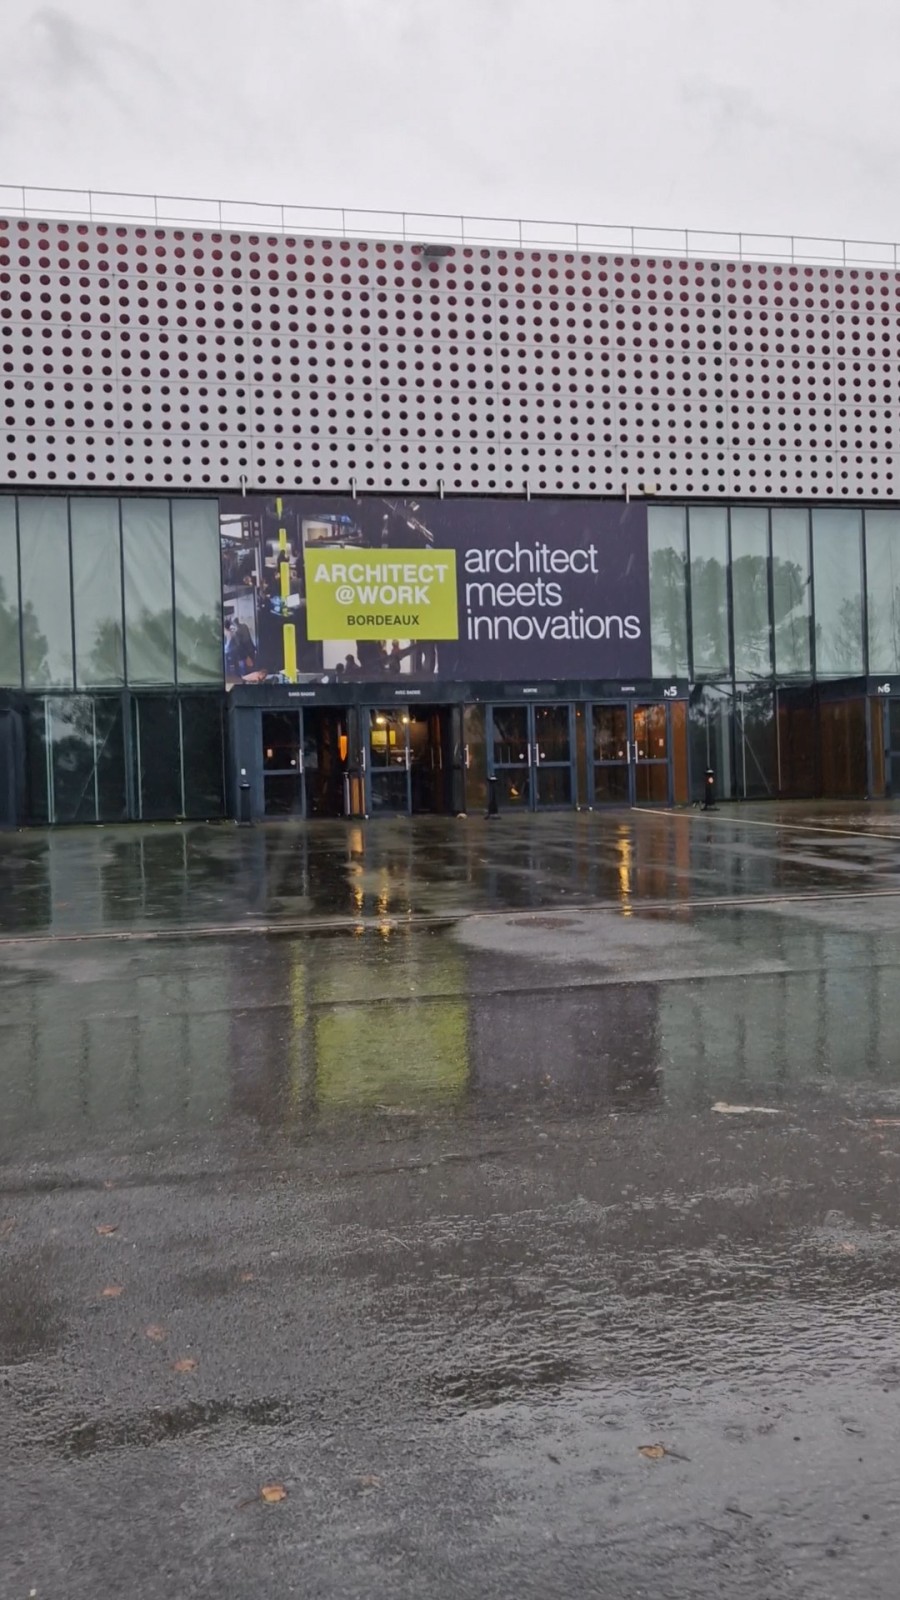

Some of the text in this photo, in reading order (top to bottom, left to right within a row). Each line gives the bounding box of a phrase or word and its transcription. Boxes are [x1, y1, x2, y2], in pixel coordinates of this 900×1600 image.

[464, 541, 599, 573] architect
[314, 563, 449, 583] ARCHITECT
[335, 585, 431, 605] @WORK
[465, 577, 563, 607] meets
[347, 615, 420, 626] BORDEAUX
[467, 608, 641, 640] innovations
[663, 686, 678, 697] N5
[877, 683, 891, 694] N6
